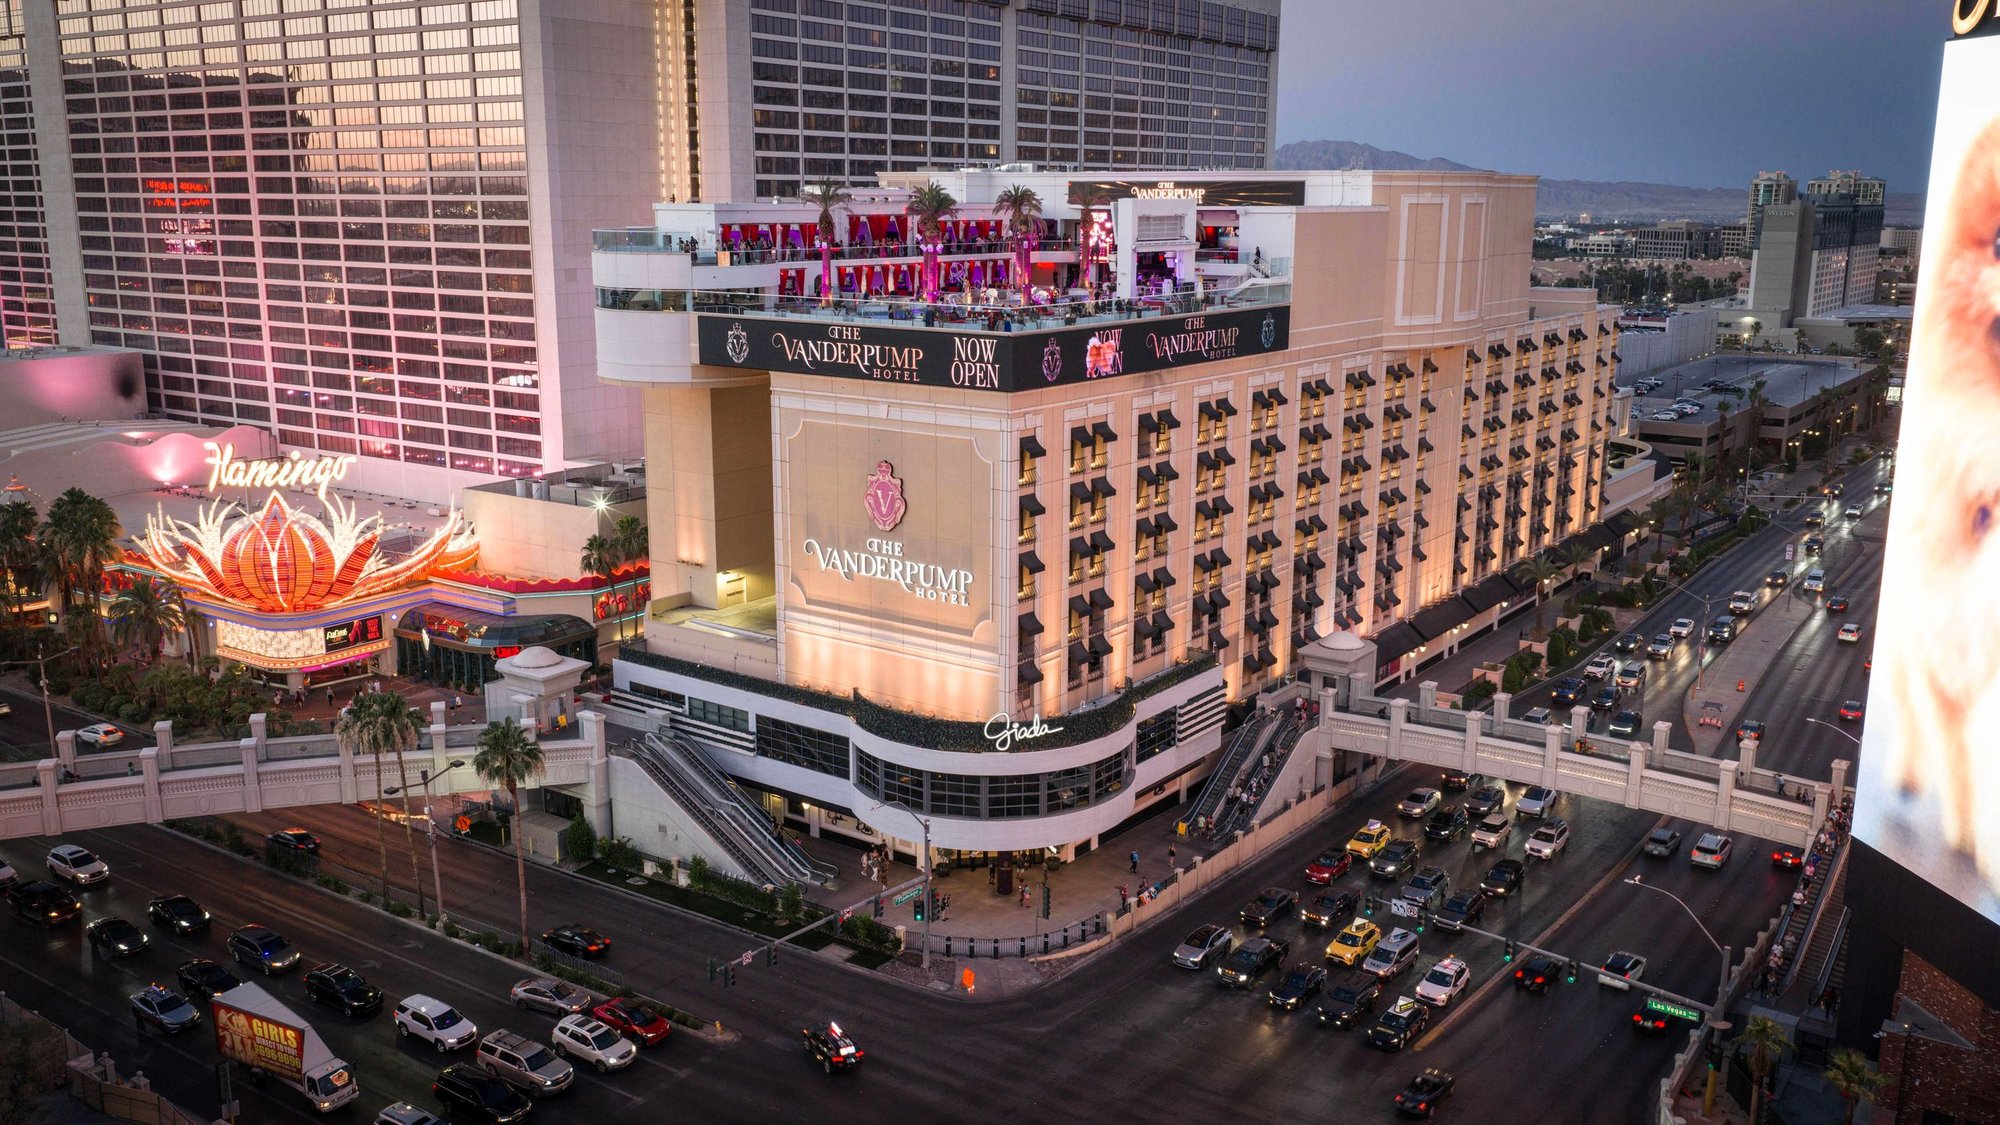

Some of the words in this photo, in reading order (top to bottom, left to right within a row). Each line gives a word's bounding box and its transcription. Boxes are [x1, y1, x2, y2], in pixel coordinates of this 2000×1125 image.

[1131, 187, 1205, 199] VANDERPUMP
[828, 325, 861, 341] THE
[1184, 317, 1205, 330] THE
[771, 332, 924, 374] VANDERPUMP
[953, 337, 997, 363] NOW
[1146, 327, 1240, 362] VANDERPUMP
[1209, 349, 1237, 360] HOTEL
[873, 368, 920, 382] HOTEL
[951, 361, 1000, 389] OPEN
[203, 441, 358, 500] Flamingo
[866, 538, 904, 556] THE
[803, 539, 974, 593] VANDERPUMP
[916, 588, 970, 607] HOTEL
[983, 712, 1064, 751] Giada
[1652, 1001, 1665, 1010] Las
[1667, 1005, 1687, 1016] Vegas
[252, 1018, 298, 1047] GIRLS
